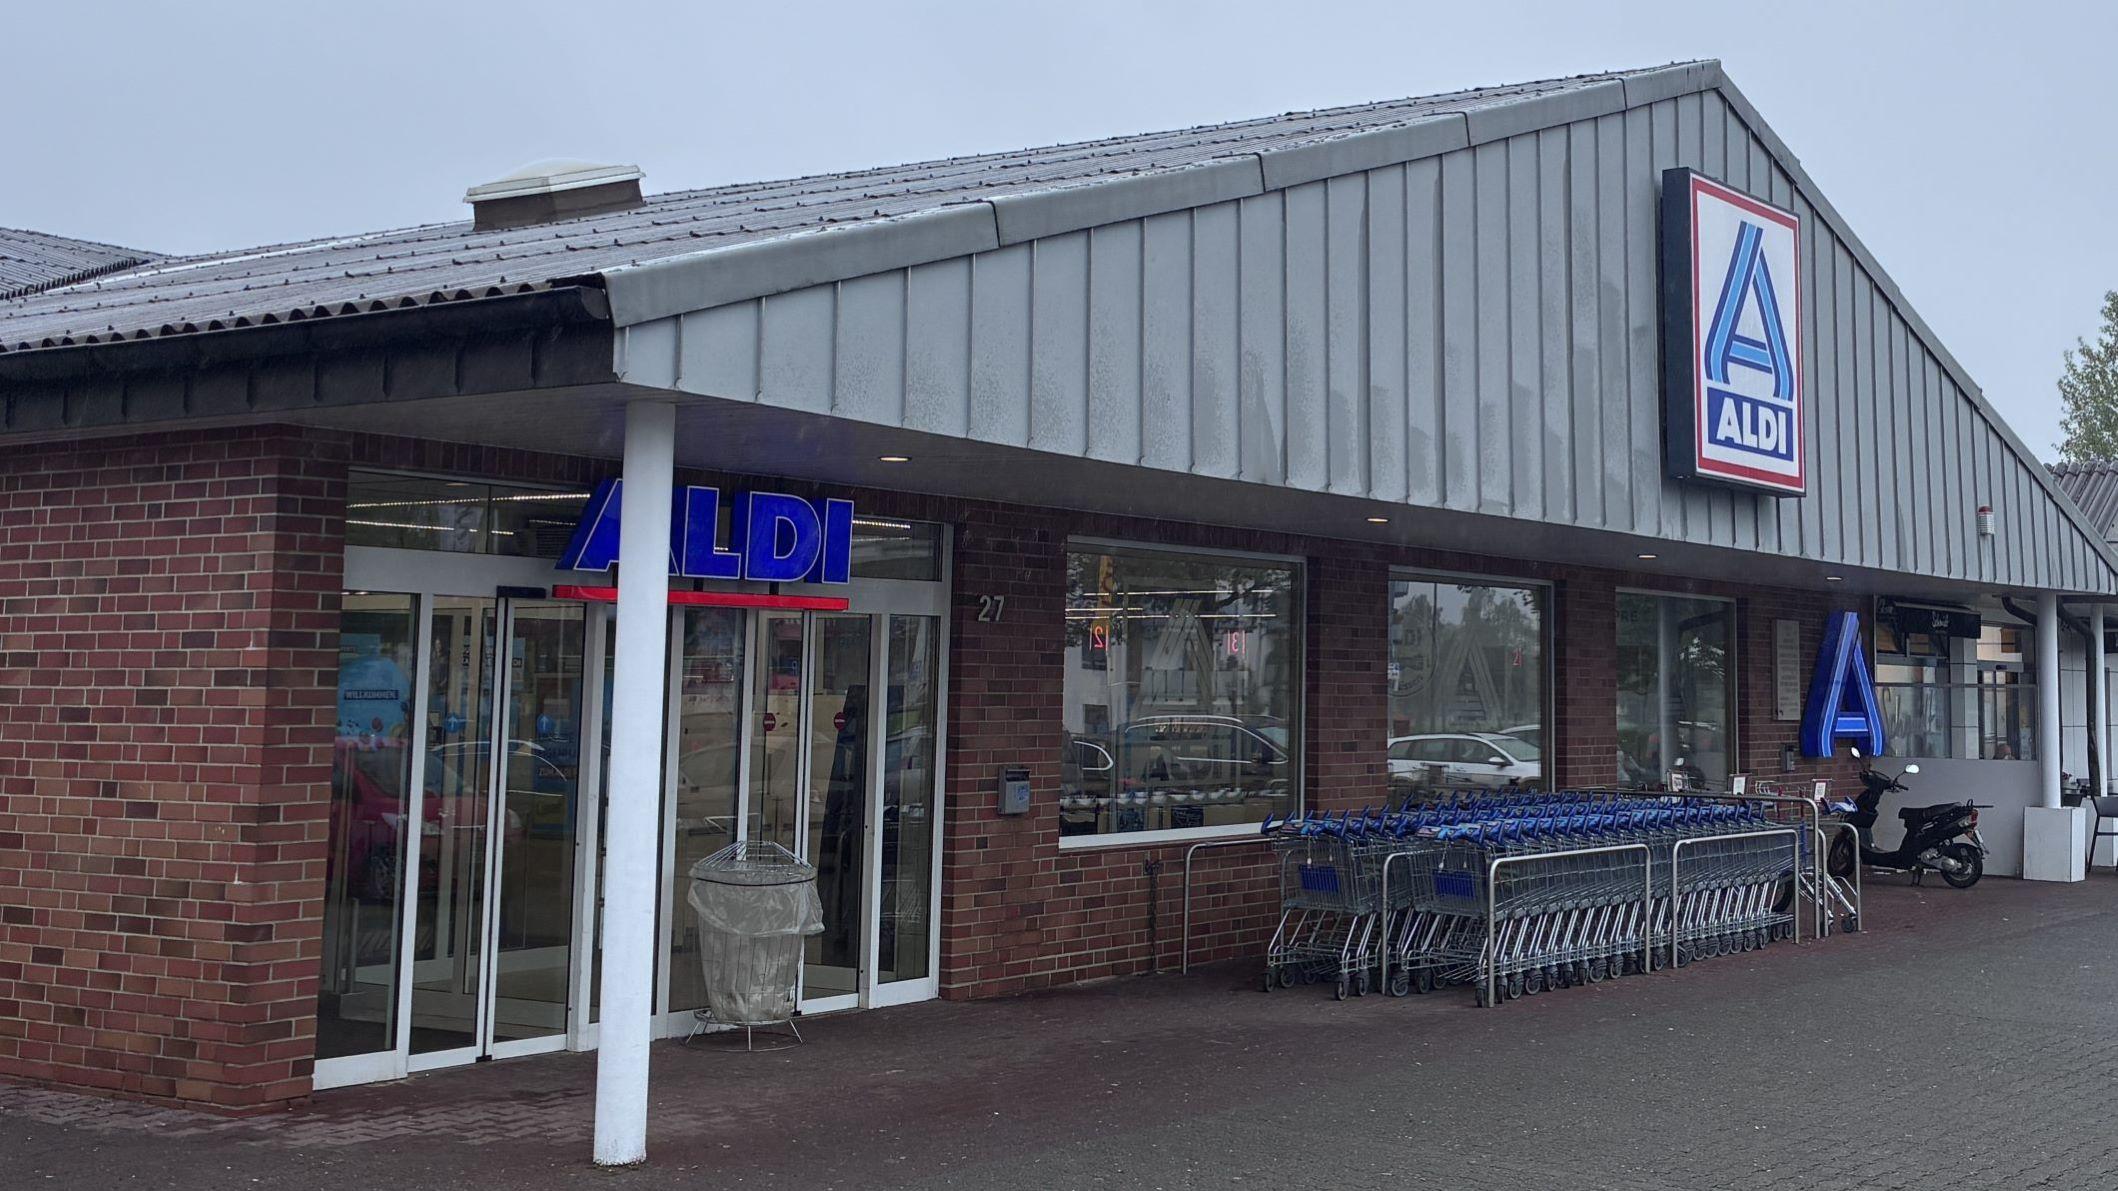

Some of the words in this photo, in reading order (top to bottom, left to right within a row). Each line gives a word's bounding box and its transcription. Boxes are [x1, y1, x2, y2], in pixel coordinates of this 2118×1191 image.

[1716, 397, 1788, 455] ALDI
[978, 595, 1005, 622] 27
[1814, 611, 1885, 758] A
